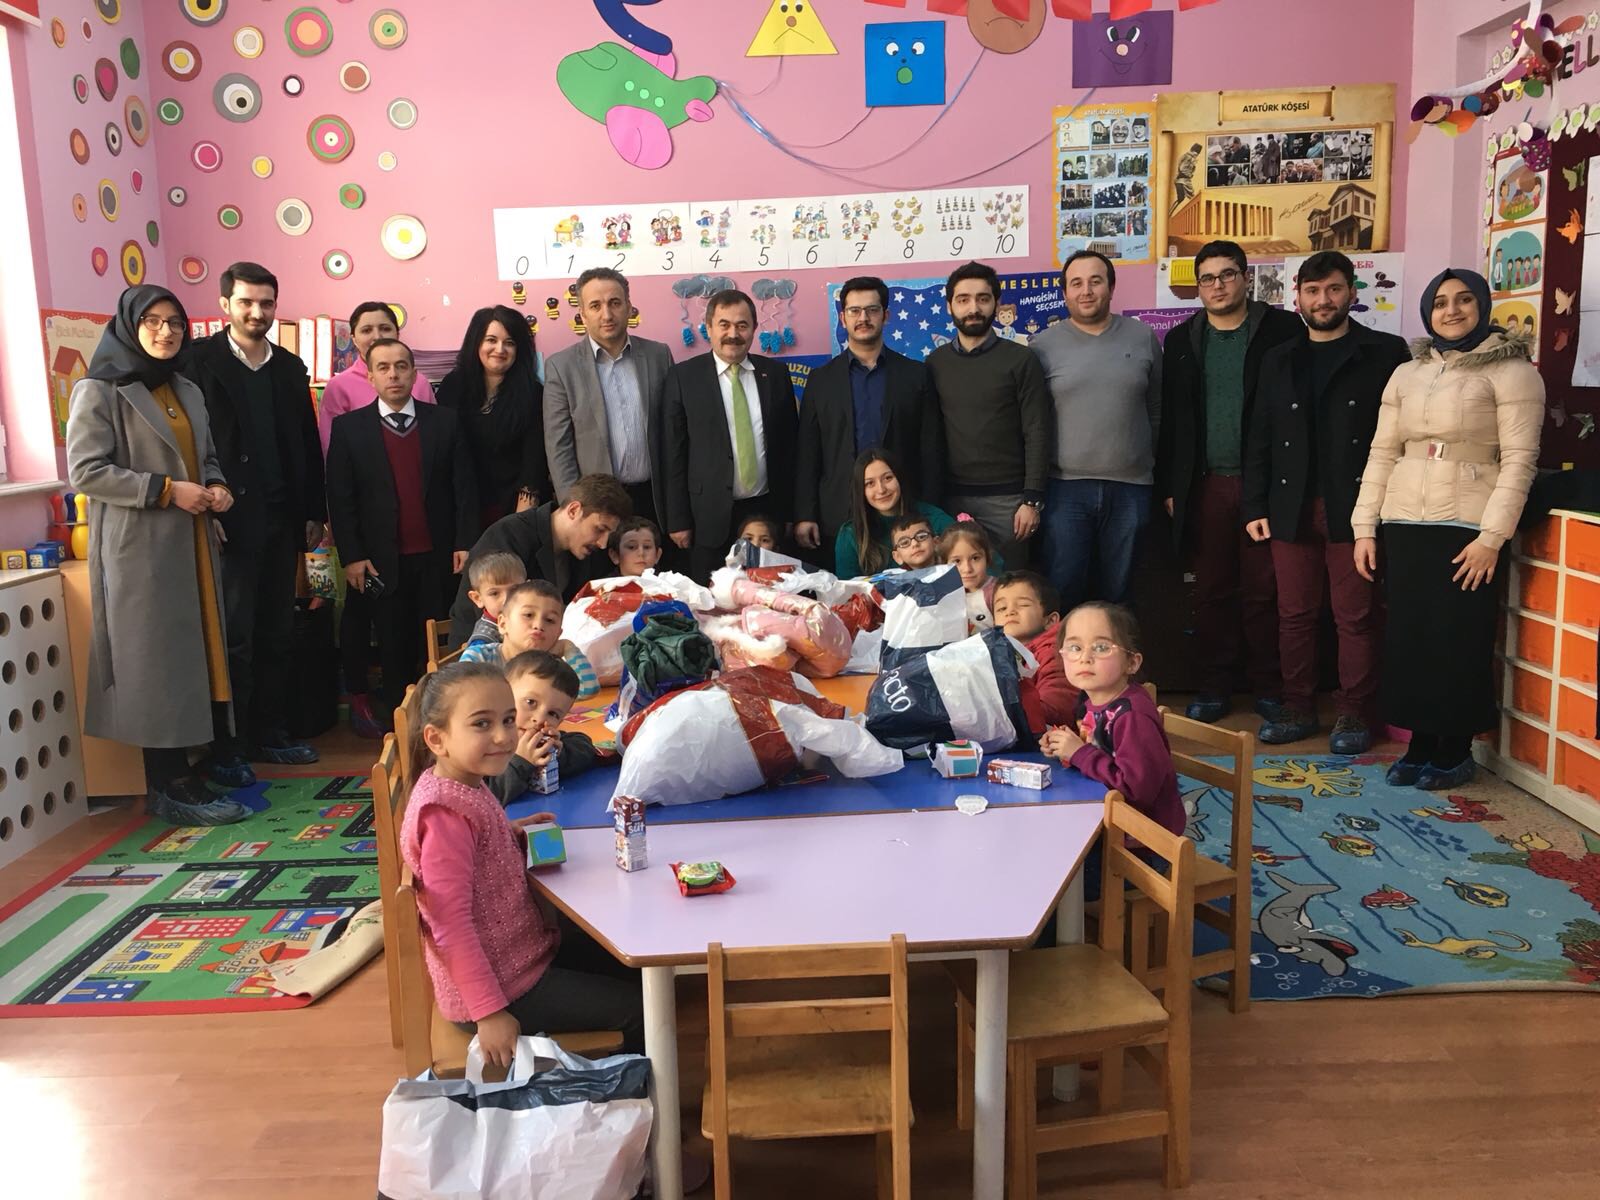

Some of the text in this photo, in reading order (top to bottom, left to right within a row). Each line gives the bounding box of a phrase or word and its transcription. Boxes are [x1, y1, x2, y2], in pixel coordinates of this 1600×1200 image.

[1243, 100, 1310, 113] ATATÜRK KÖŞESİ
[516, 233, 1015, 276] 0 1 2 3 4 5 6 7 8 9 10
[1353, 260, 1374, 269] ER
[1000, 277, 1061, 290] MESLEK
[1020, 290, 1058, 305] HANGİSİNİ
[1035, 300, 1066, 312] SEÇSEM
